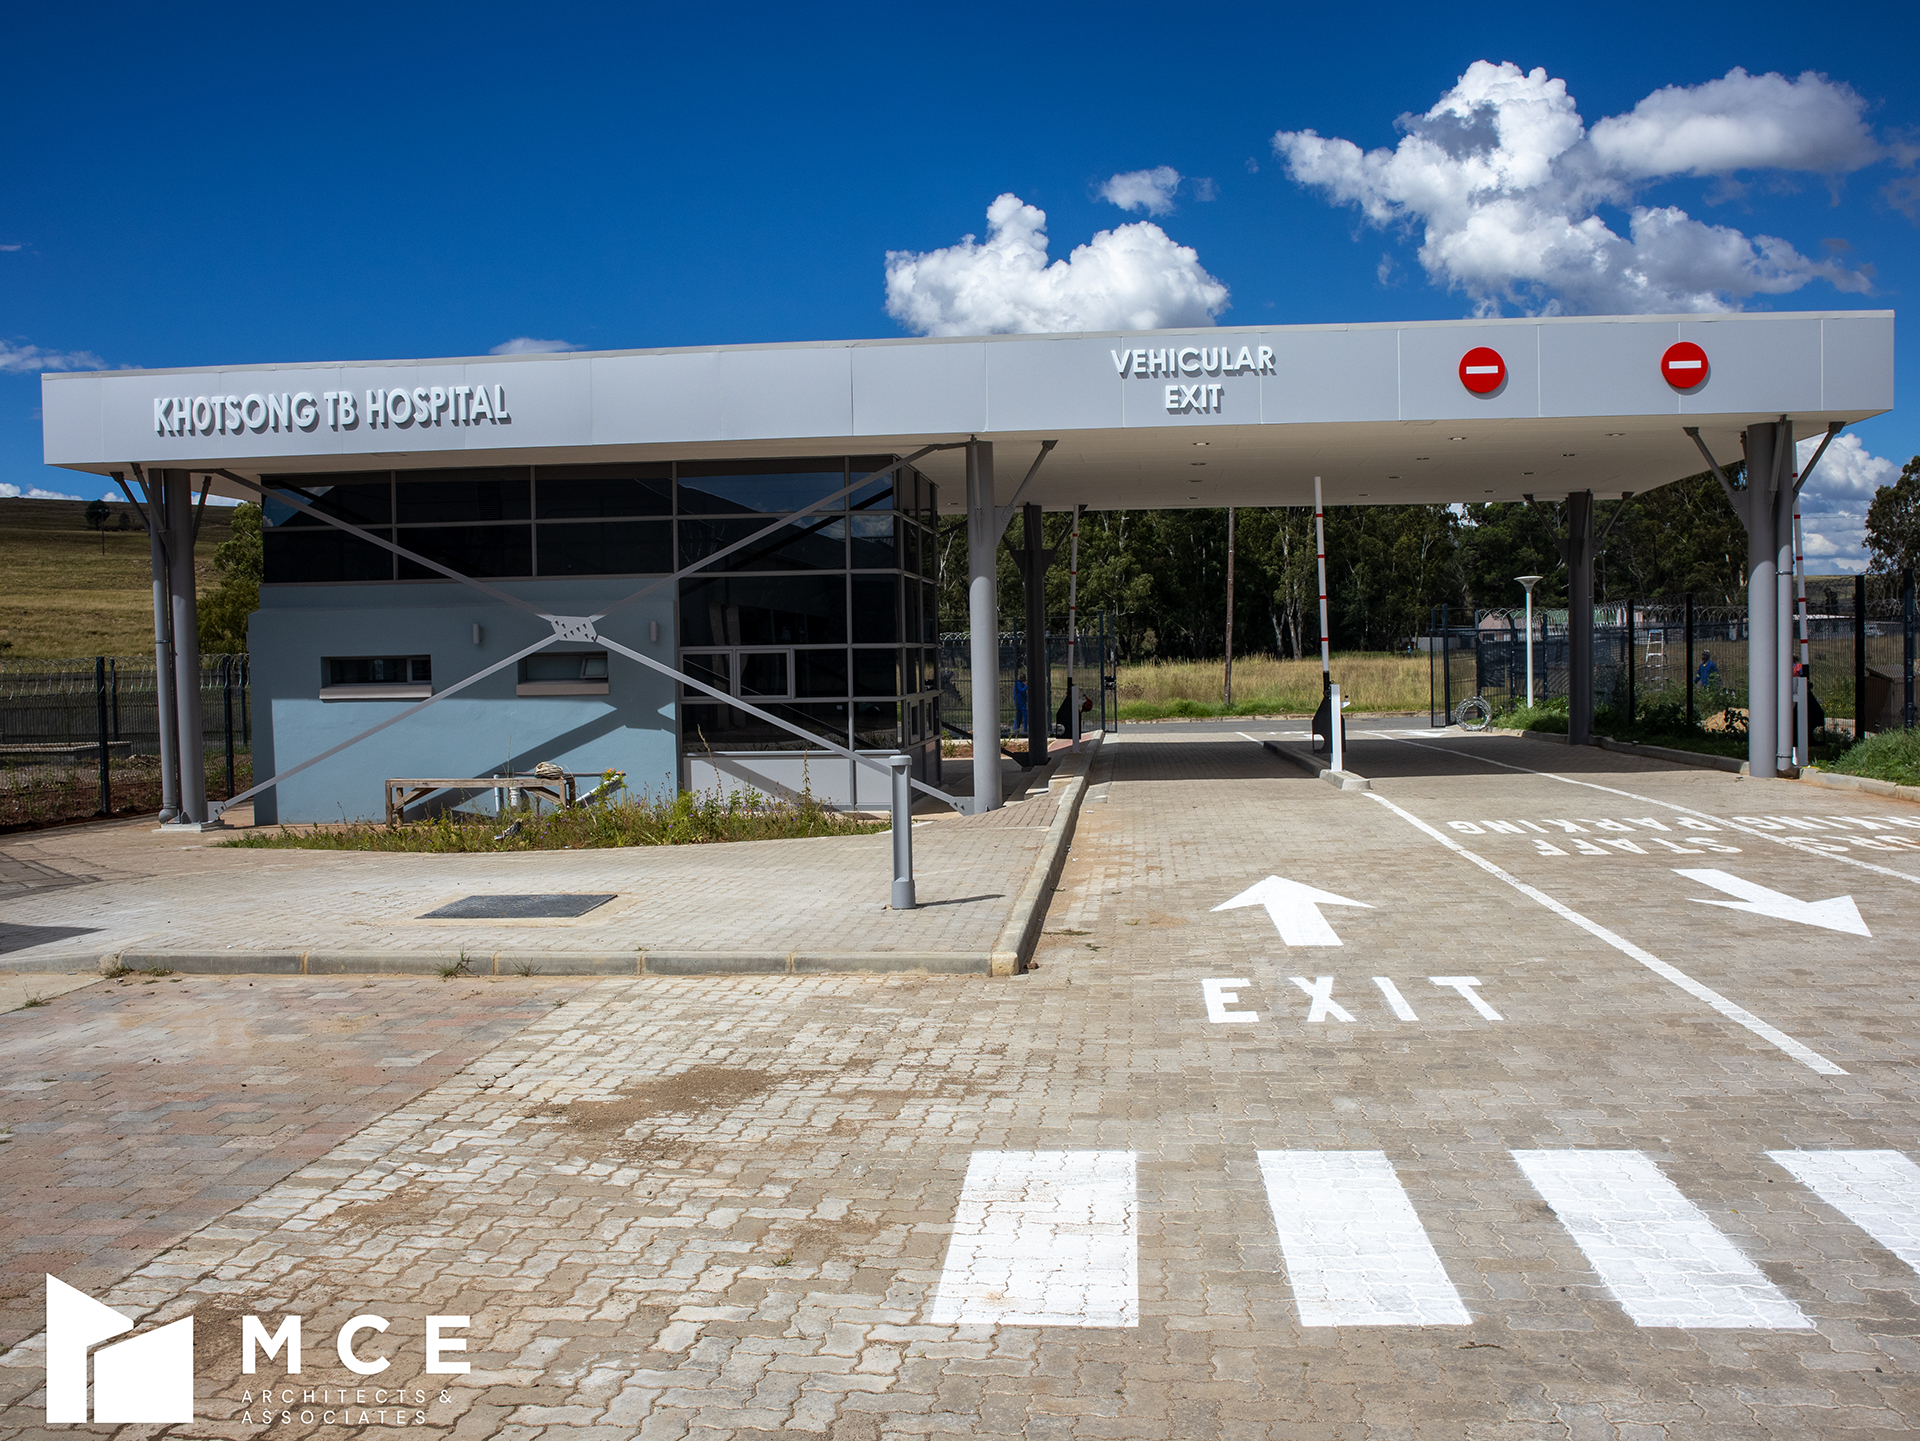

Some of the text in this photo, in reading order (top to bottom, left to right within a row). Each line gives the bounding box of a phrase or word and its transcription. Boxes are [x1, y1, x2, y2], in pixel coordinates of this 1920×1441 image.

[1110, 345, 1276, 377] VEHICULAR
[153, 384, 512, 435] KHOTSONG TB HOSPITAL
[1165, 383, 1224, 414] EXIT
[1447, 816, 1722, 834] PARKING
[1532, 836, 1742, 855] STAFF
[1201, 976, 1504, 1023] EXIT
